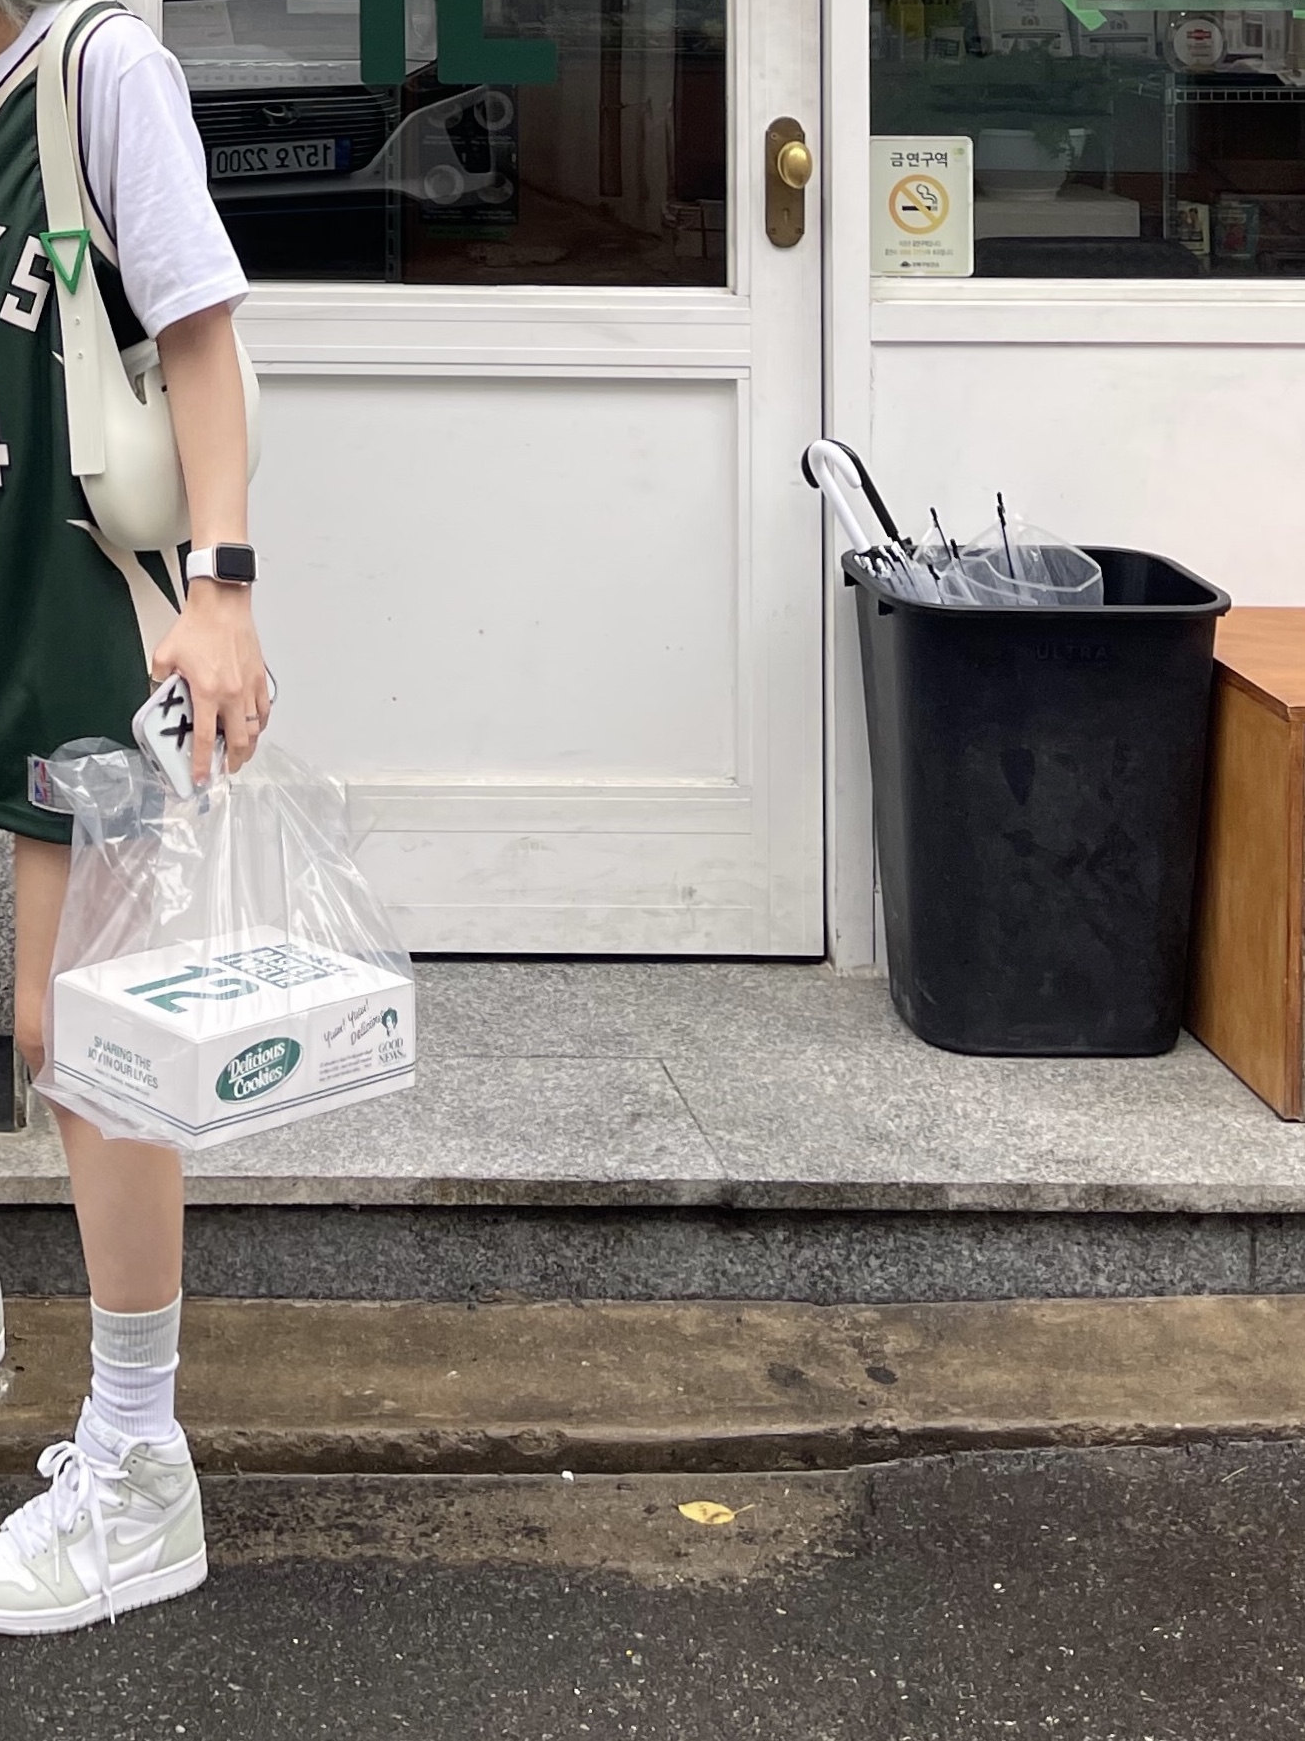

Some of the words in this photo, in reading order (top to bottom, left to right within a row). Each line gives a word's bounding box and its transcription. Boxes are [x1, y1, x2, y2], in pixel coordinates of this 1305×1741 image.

[890, 151, 948, 168] 금연구역
[123, 965, 259, 1014] 12
[94, 1036, 132, 1062] SHARING
[134, 1054, 151, 1070] THE
[227, 1042, 286, 1079] Delicious
[378, 1038, 403, 1053] GOOD
[114, 1060, 132, 1077] OUR
[134, 1069, 158, 1089] LIVES
[233, 1065, 283, 1098] Cookies
